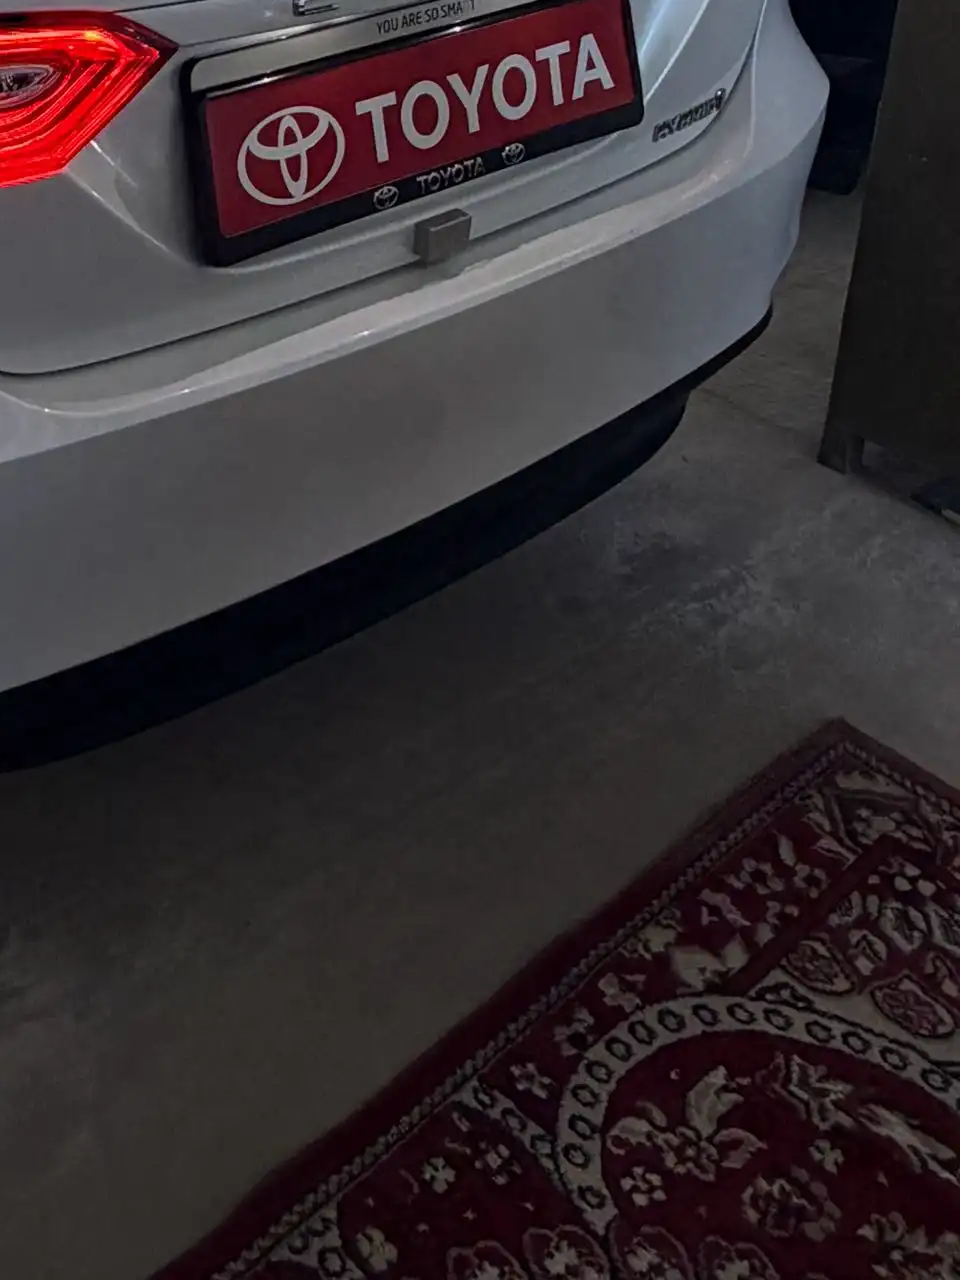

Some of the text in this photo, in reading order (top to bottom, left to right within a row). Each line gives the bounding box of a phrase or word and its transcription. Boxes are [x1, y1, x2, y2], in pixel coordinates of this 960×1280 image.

[376, 17, 399, 35] YOU
[400, 11, 424, 29] ARE
[424, 6, 439, 23] SO
[355, 33, 616, 164] TOYOTA
[416, 156, 486, 195] TOYOTA
